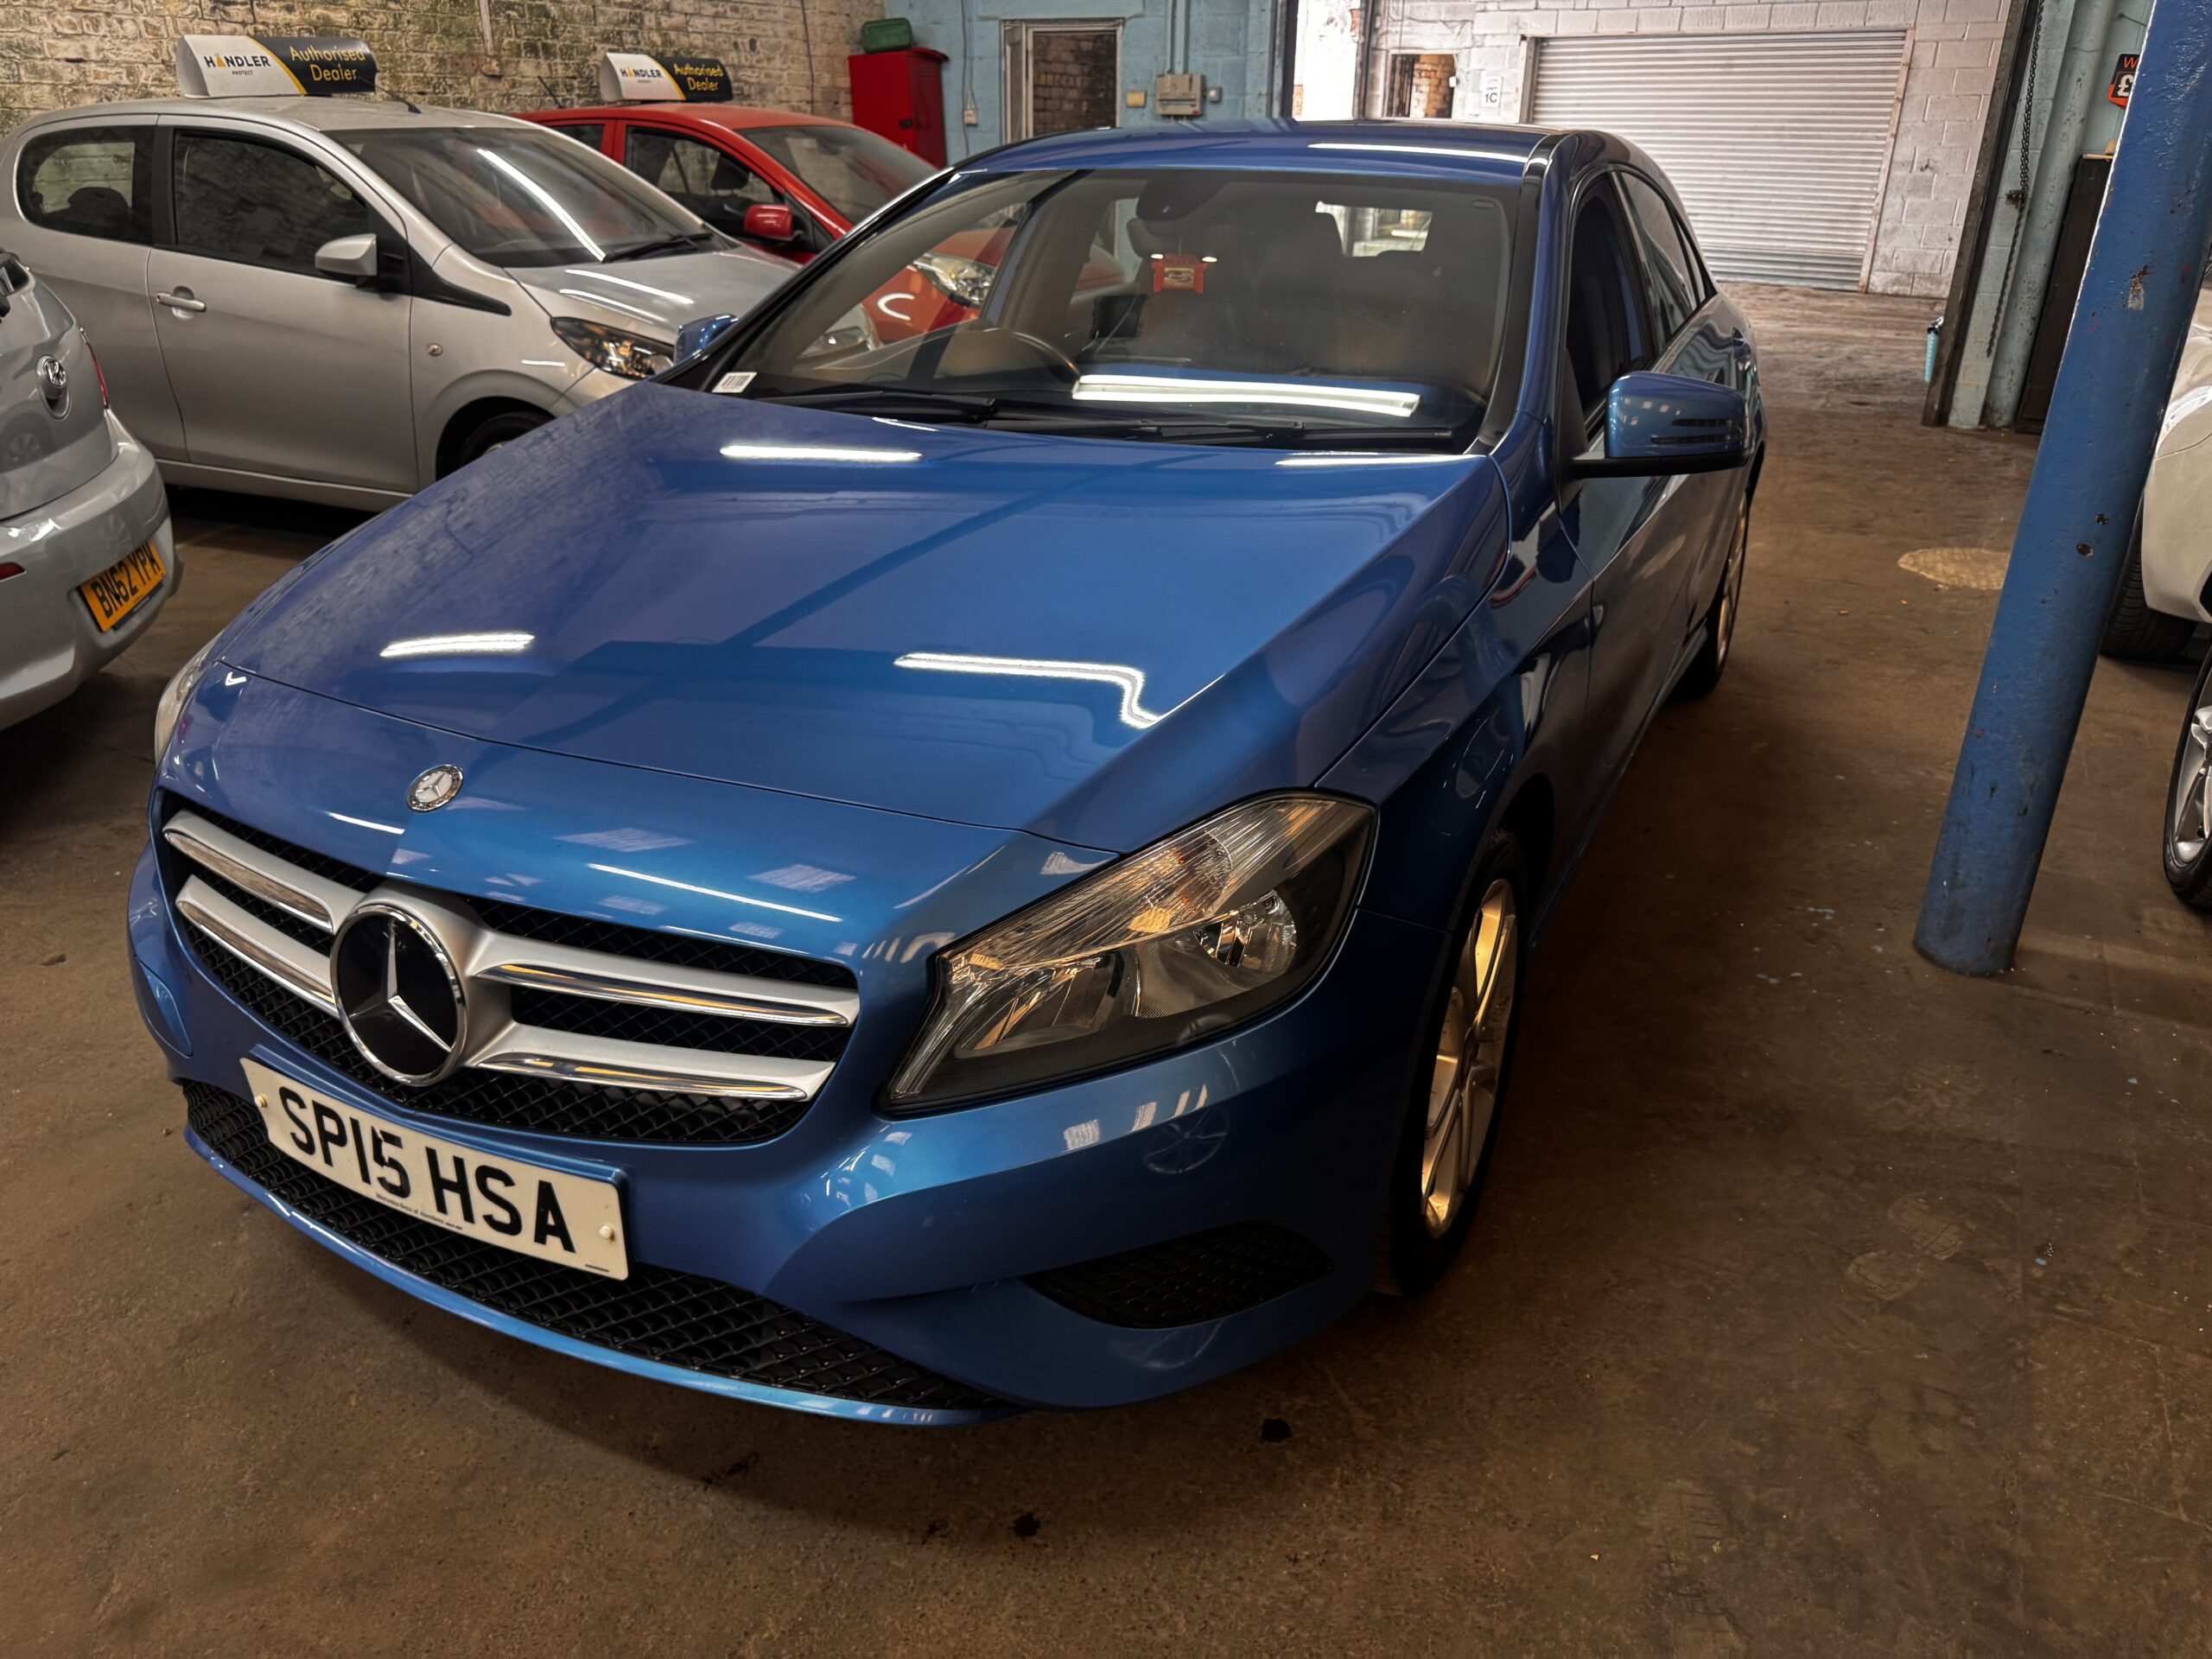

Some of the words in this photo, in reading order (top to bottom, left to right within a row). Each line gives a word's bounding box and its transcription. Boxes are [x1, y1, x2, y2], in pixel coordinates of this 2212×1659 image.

[289, 46, 365, 62] Authorised
[310, 64, 357, 81] Dealer
[674, 63, 723, 77] Authorised
[687, 77, 718, 91] Dealer
[1484, 92, 1497, 104] 1C
[91, 560, 138, 620] BN62
[279, 1086, 410, 1198] SP15
[425, 1146, 575, 1254] HSA
